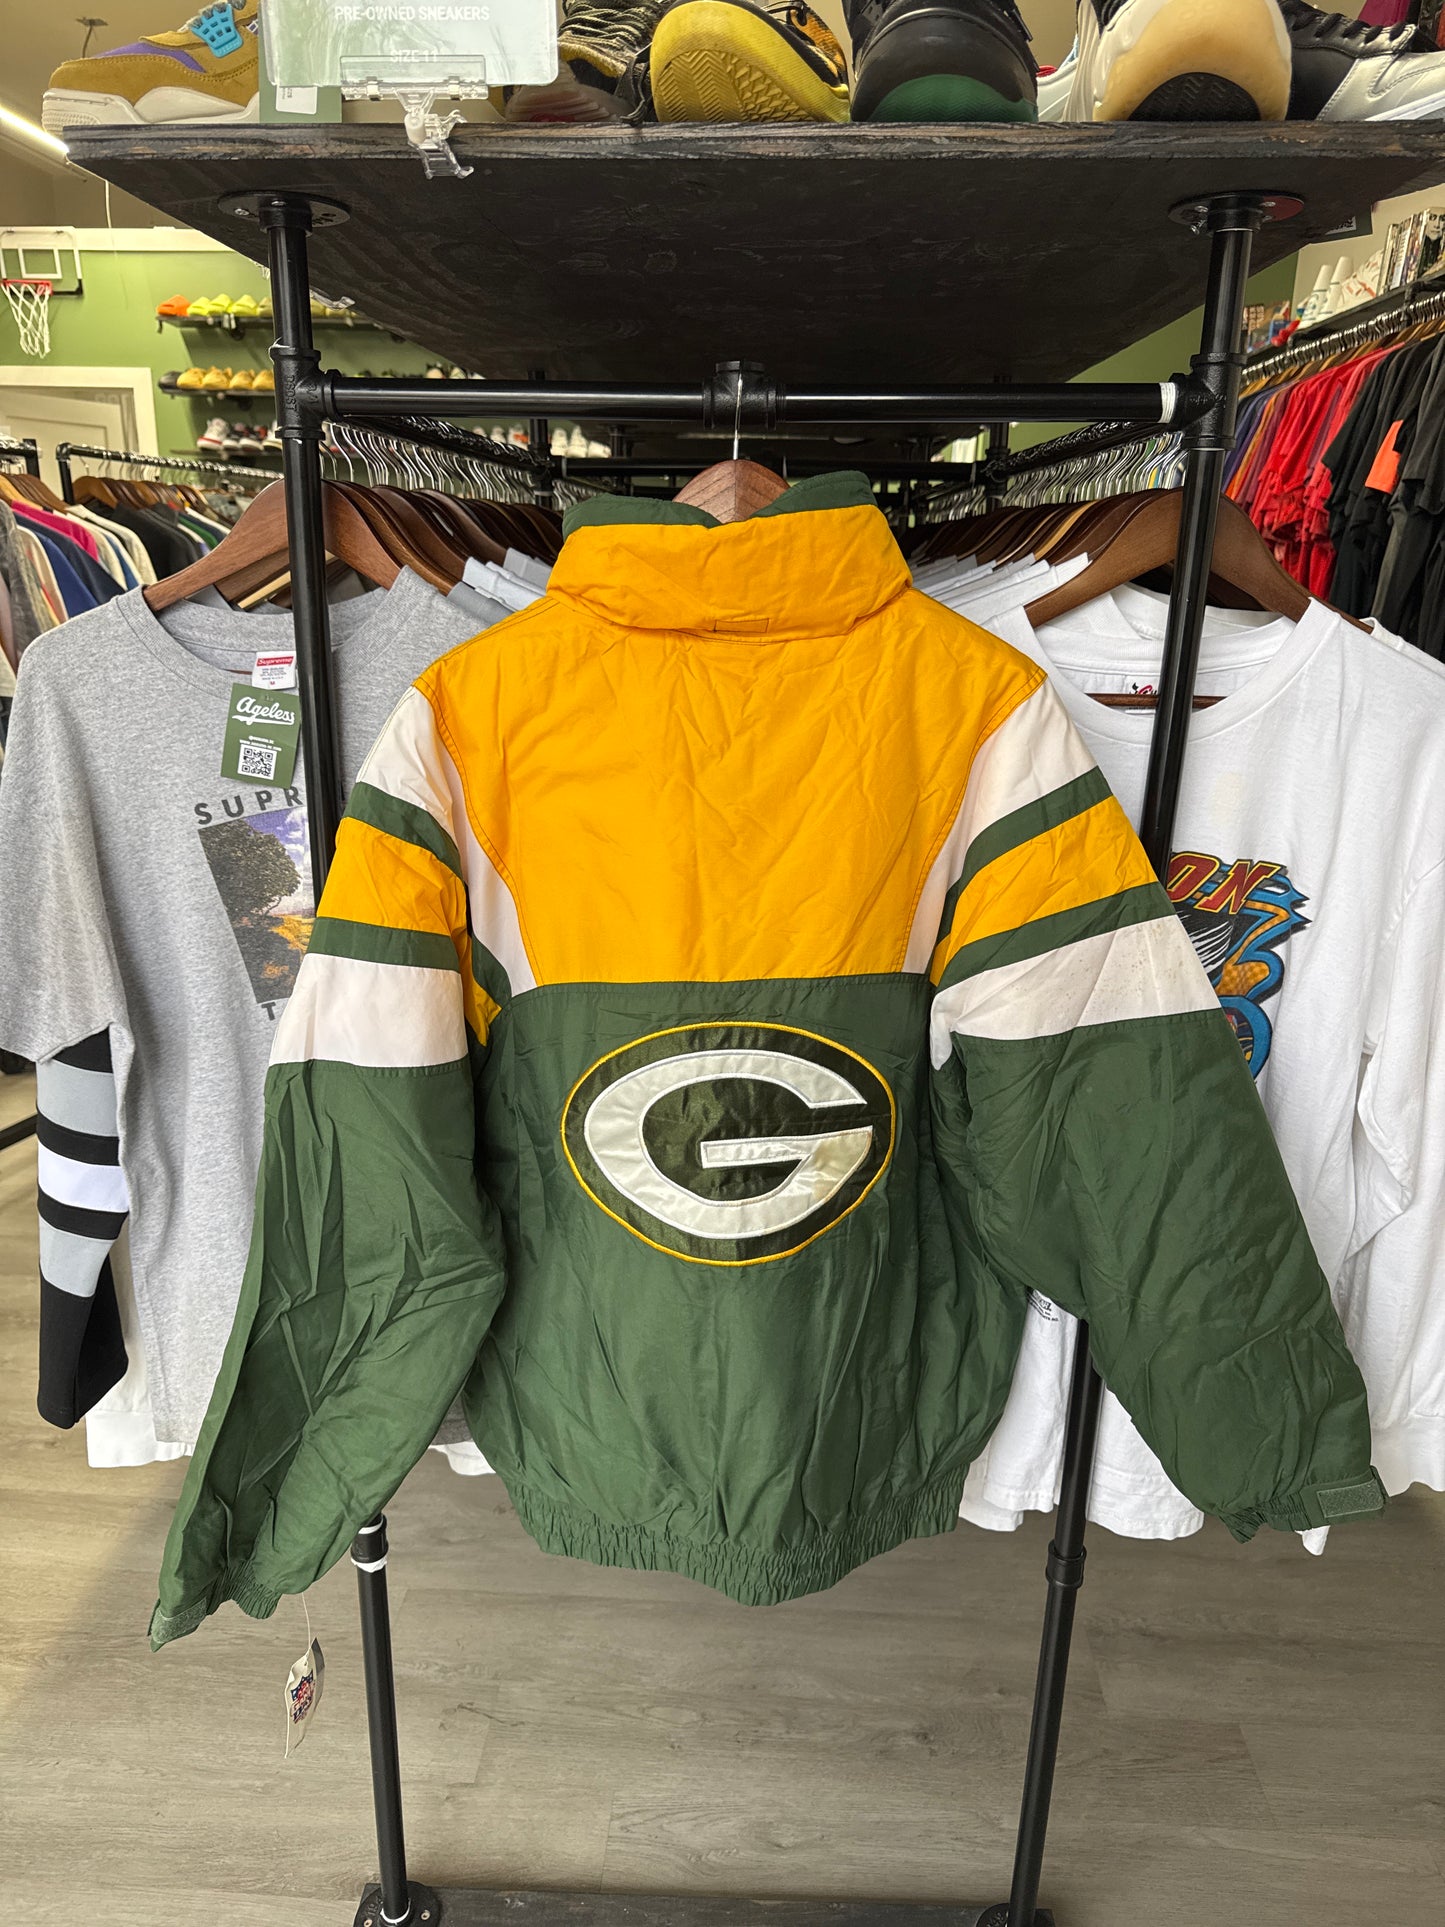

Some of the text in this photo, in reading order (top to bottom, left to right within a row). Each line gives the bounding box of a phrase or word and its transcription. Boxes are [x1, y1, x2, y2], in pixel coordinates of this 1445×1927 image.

[334, 6, 490, 21] PRE-OWNED SNEAKERS
[390, 50, 438, 63] SIZE 11
[231, 696, 295, 726] Ageless
[584, 1049, 873, 1240] G
